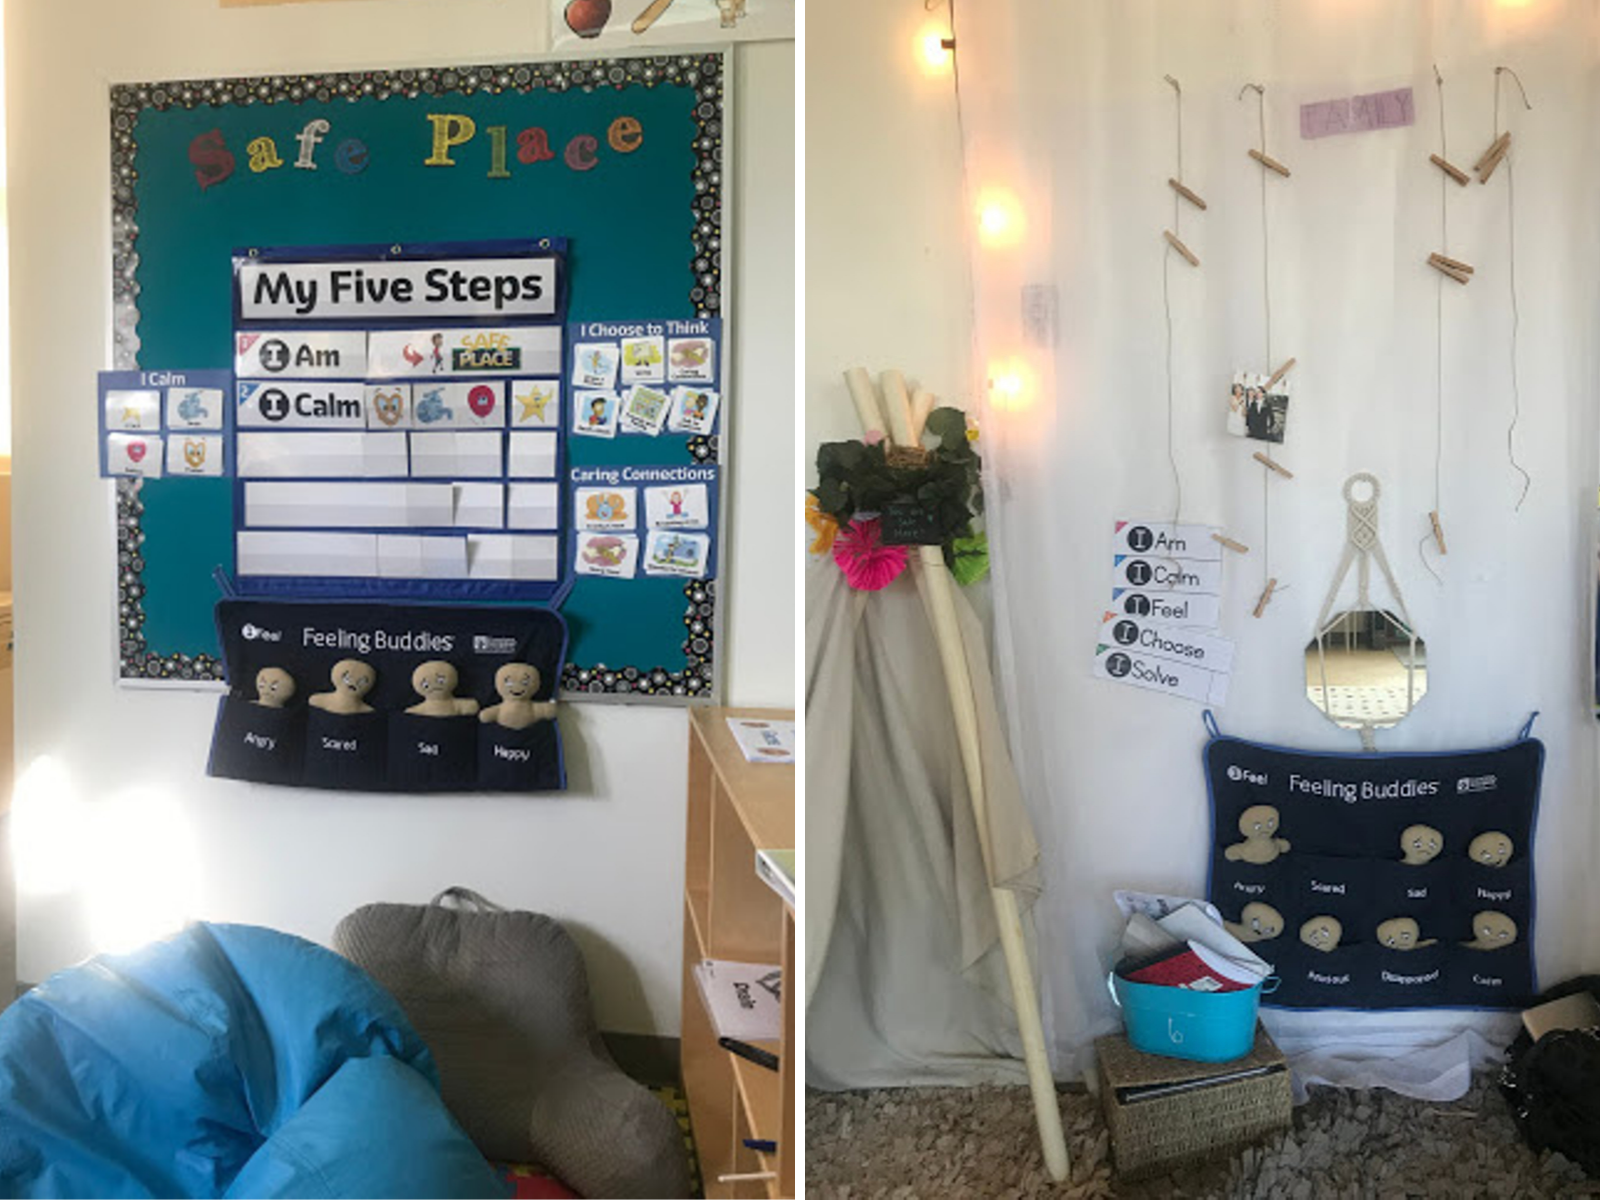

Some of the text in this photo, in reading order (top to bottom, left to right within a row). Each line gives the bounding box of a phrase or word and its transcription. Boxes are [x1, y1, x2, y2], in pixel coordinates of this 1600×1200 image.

[188, 113, 644, 191] Safe Place
[253, 268, 542, 315] My Five Steps
[581, 321, 709, 337] I Choose to Think
[461, 332, 509, 353] SAFE
[295, 343, 340, 367] Am
[460, 350, 513, 367] PLACE
[141, 371, 186, 386] I Calm
[295, 392, 361, 418] Calm
[571, 467, 715, 484] Caring Connections
[1154, 532, 1186, 551] Am
[1154, 565, 1200, 586] Calm
[1152, 599, 1188, 619] Feel
[303, 627, 371, 654] Feeling
[375, 630, 453, 652] Buddies
[1140, 629, 1205, 659] Choose
[1131, 660, 1179, 686] Solve
[244, 731, 276, 750] Angry
[322, 737, 357, 750] Scared
[418, 742, 439, 756] Sad
[494, 744, 530, 762] Happy
[1243, 770, 1268, 785] Feel
[1289, 774, 1357, 803] Feeling
[1361, 779, 1439, 800] Buddies
